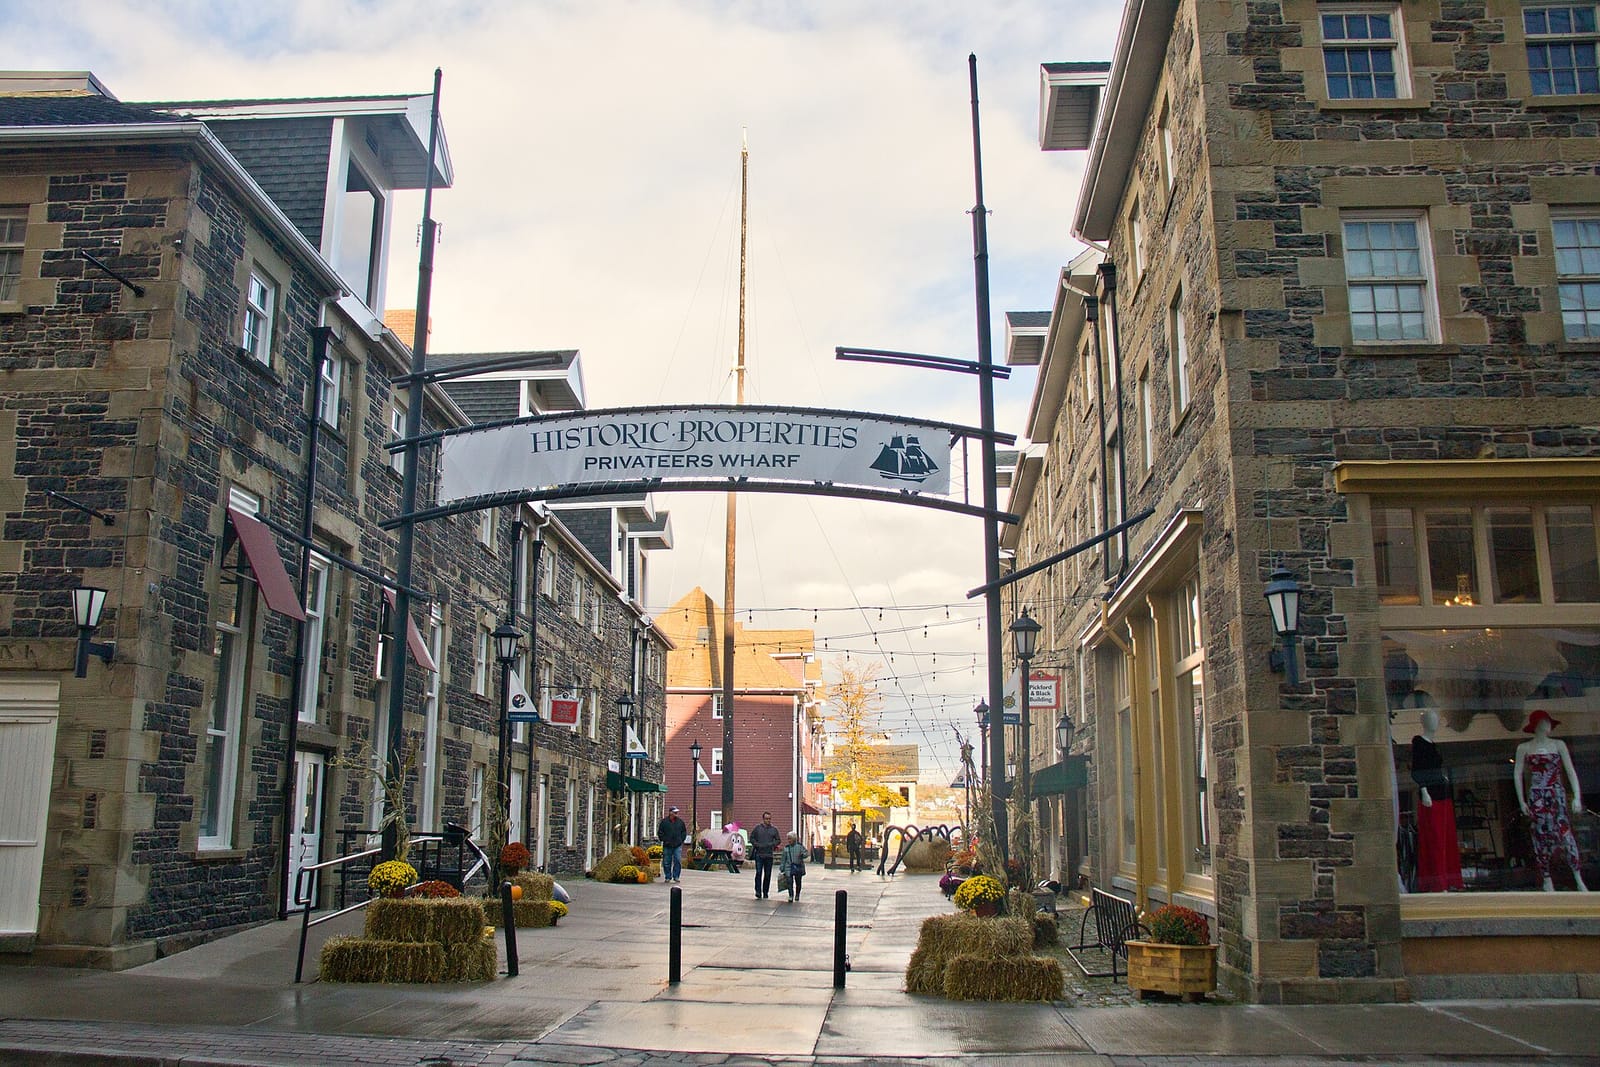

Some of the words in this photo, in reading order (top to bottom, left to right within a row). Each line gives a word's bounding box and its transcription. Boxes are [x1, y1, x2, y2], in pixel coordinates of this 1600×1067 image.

[530, 420, 669, 454] HISTORIC
[678, 420, 858, 450] PROPERTIES
[584, 455, 714, 470] PRIVATEERS
[718, 454, 801, 468] WHARF
